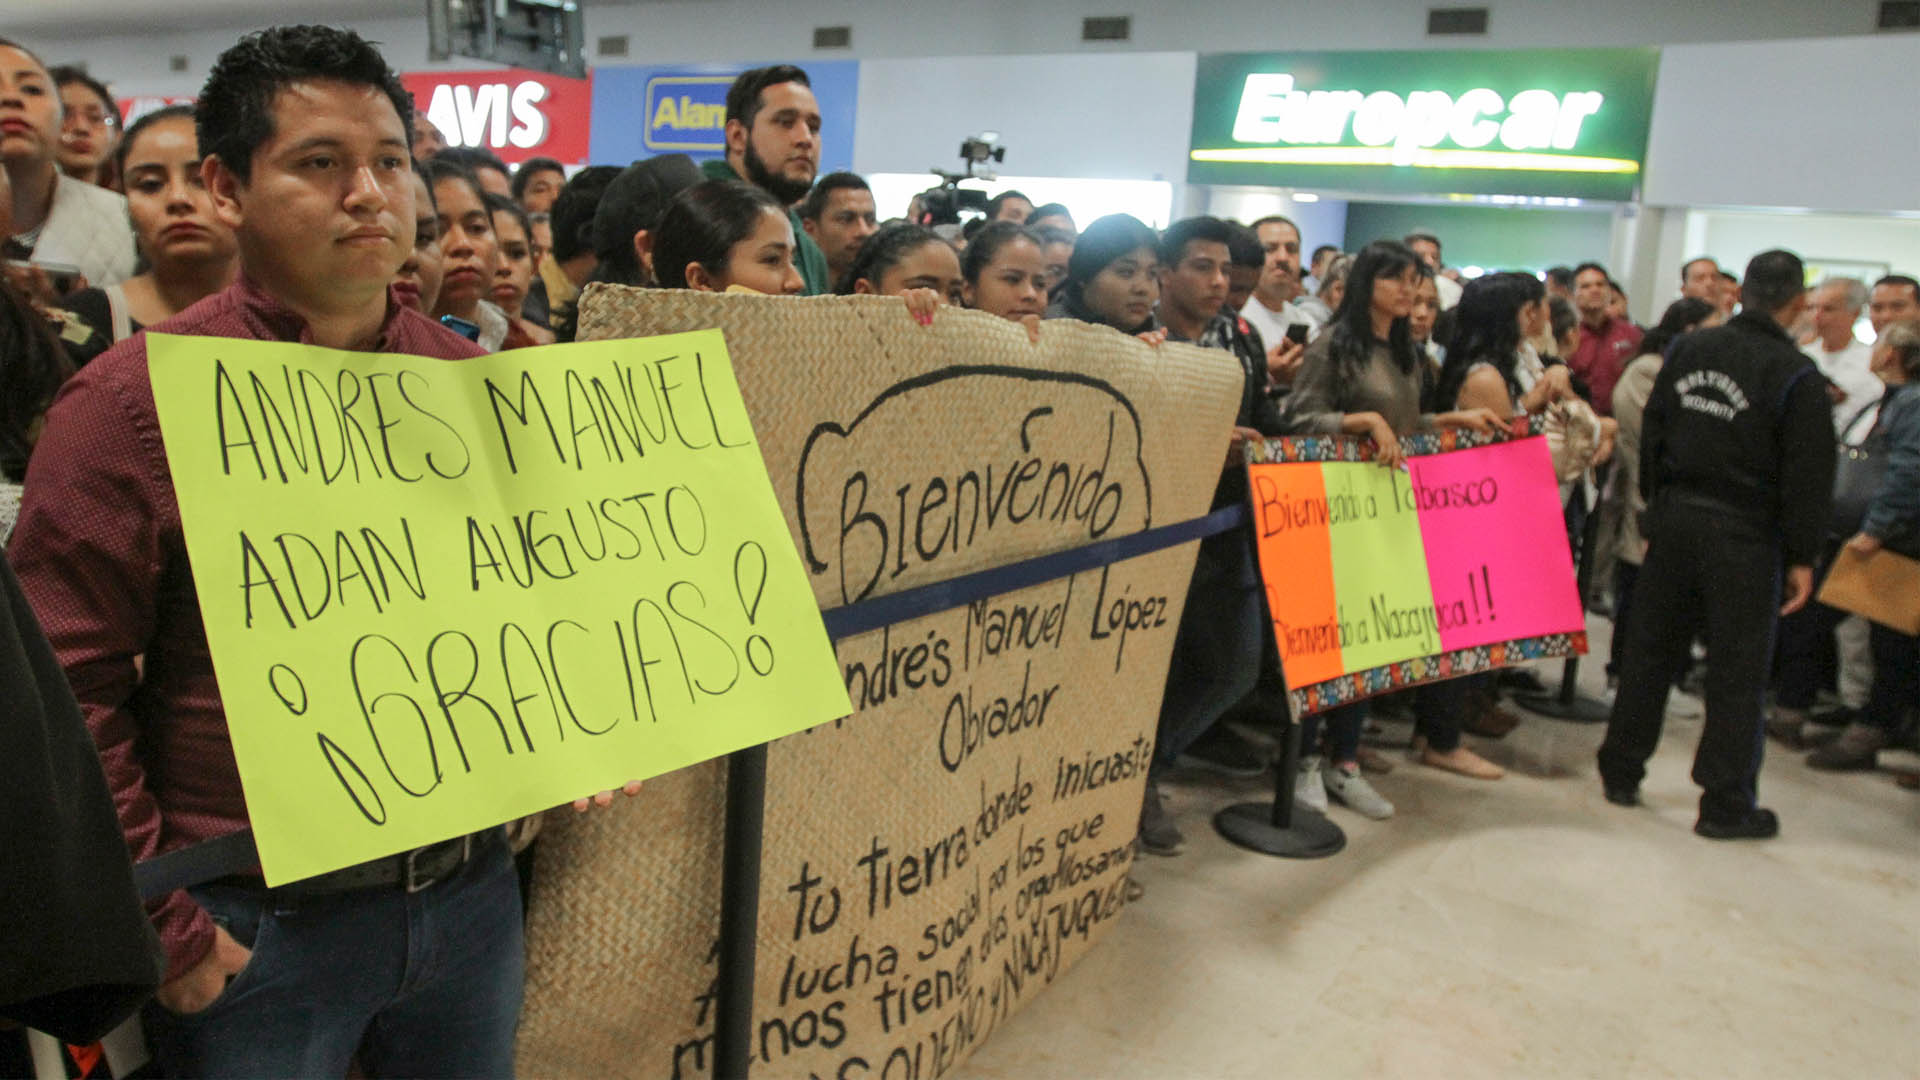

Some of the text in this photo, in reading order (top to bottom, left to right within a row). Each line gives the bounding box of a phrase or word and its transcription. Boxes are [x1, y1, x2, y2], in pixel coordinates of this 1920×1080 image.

[427, 81, 546, 148] AVIS
[1233, 74, 1604, 165] Europcar
[215, 353, 751, 485] ANDRES MANUEL
[238, 485, 706, 629] ADAN AUGUSTO
[1256, 464, 1498, 538] Bienvenido a Tabasco
[834, 564, 1167, 728] ndrés Manuel López
[1358, 619, 1369, 644] a
[940, 659, 1060, 773] Obrador
[788, 861, 841, 941] tu
[973, 755, 1034, 846] donde
[778, 934, 899, 1008] lucha
[918, 862, 980, 961] social
[1017, 823, 1045, 877] los
[1056, 814, 1104, 877] que
[873, 945, 973, 1034] tienen
